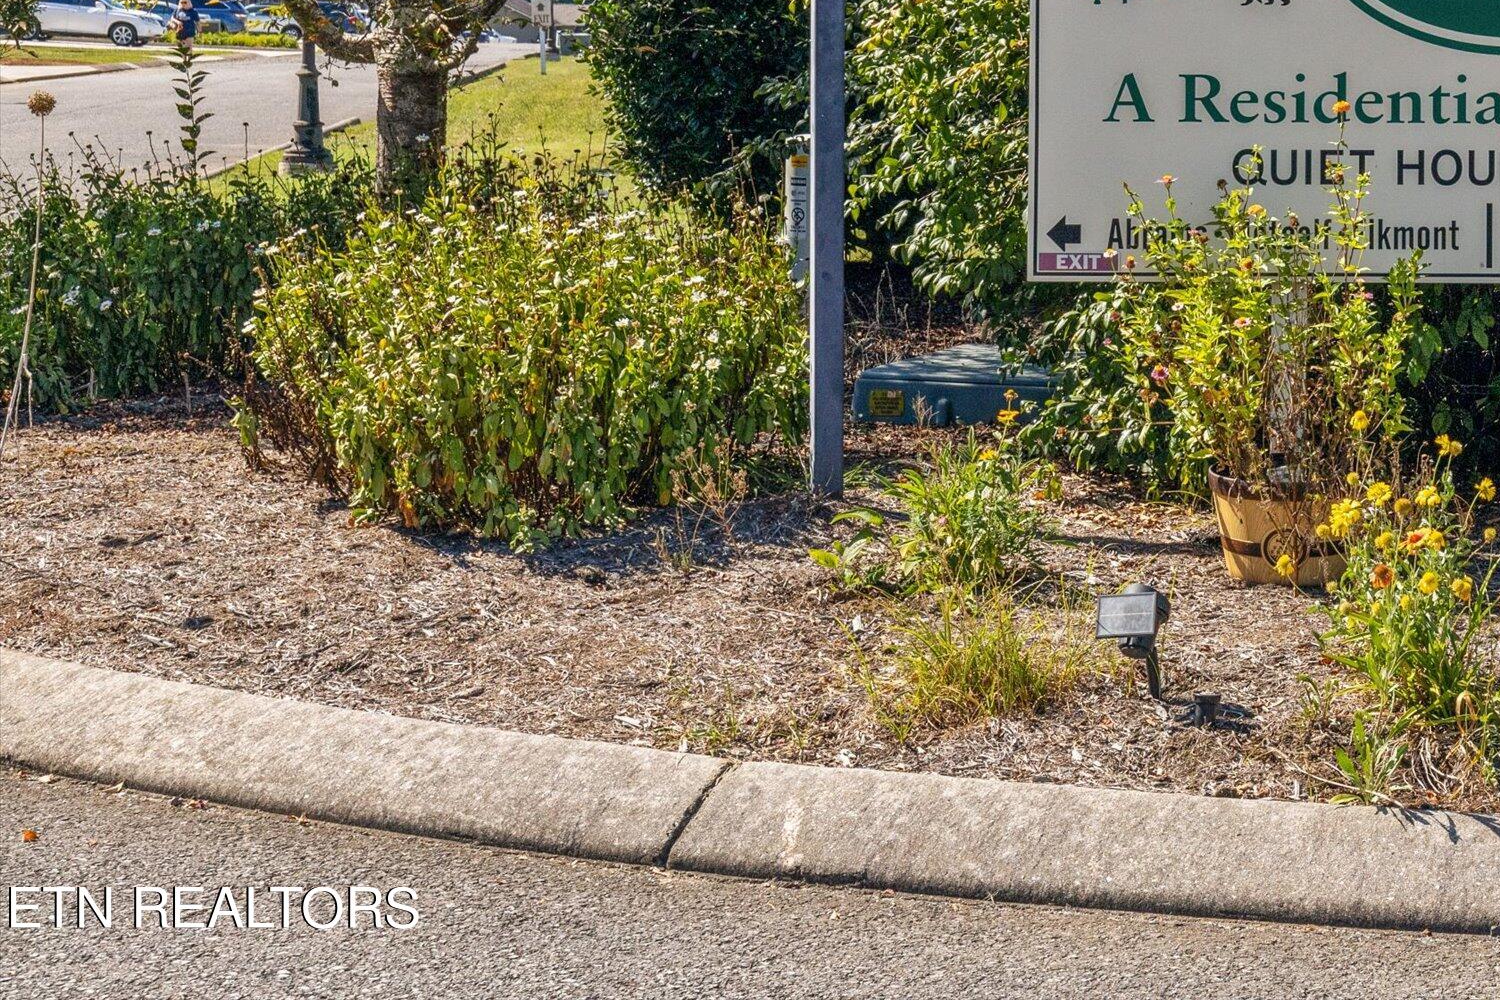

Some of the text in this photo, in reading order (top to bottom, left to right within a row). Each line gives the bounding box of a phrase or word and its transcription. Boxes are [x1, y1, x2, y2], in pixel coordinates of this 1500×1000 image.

[1102, 72, 1155, 123] A
[1232, 148, 1375, 187] QUIET
[1055, 254, 1102, 270] EXIT
